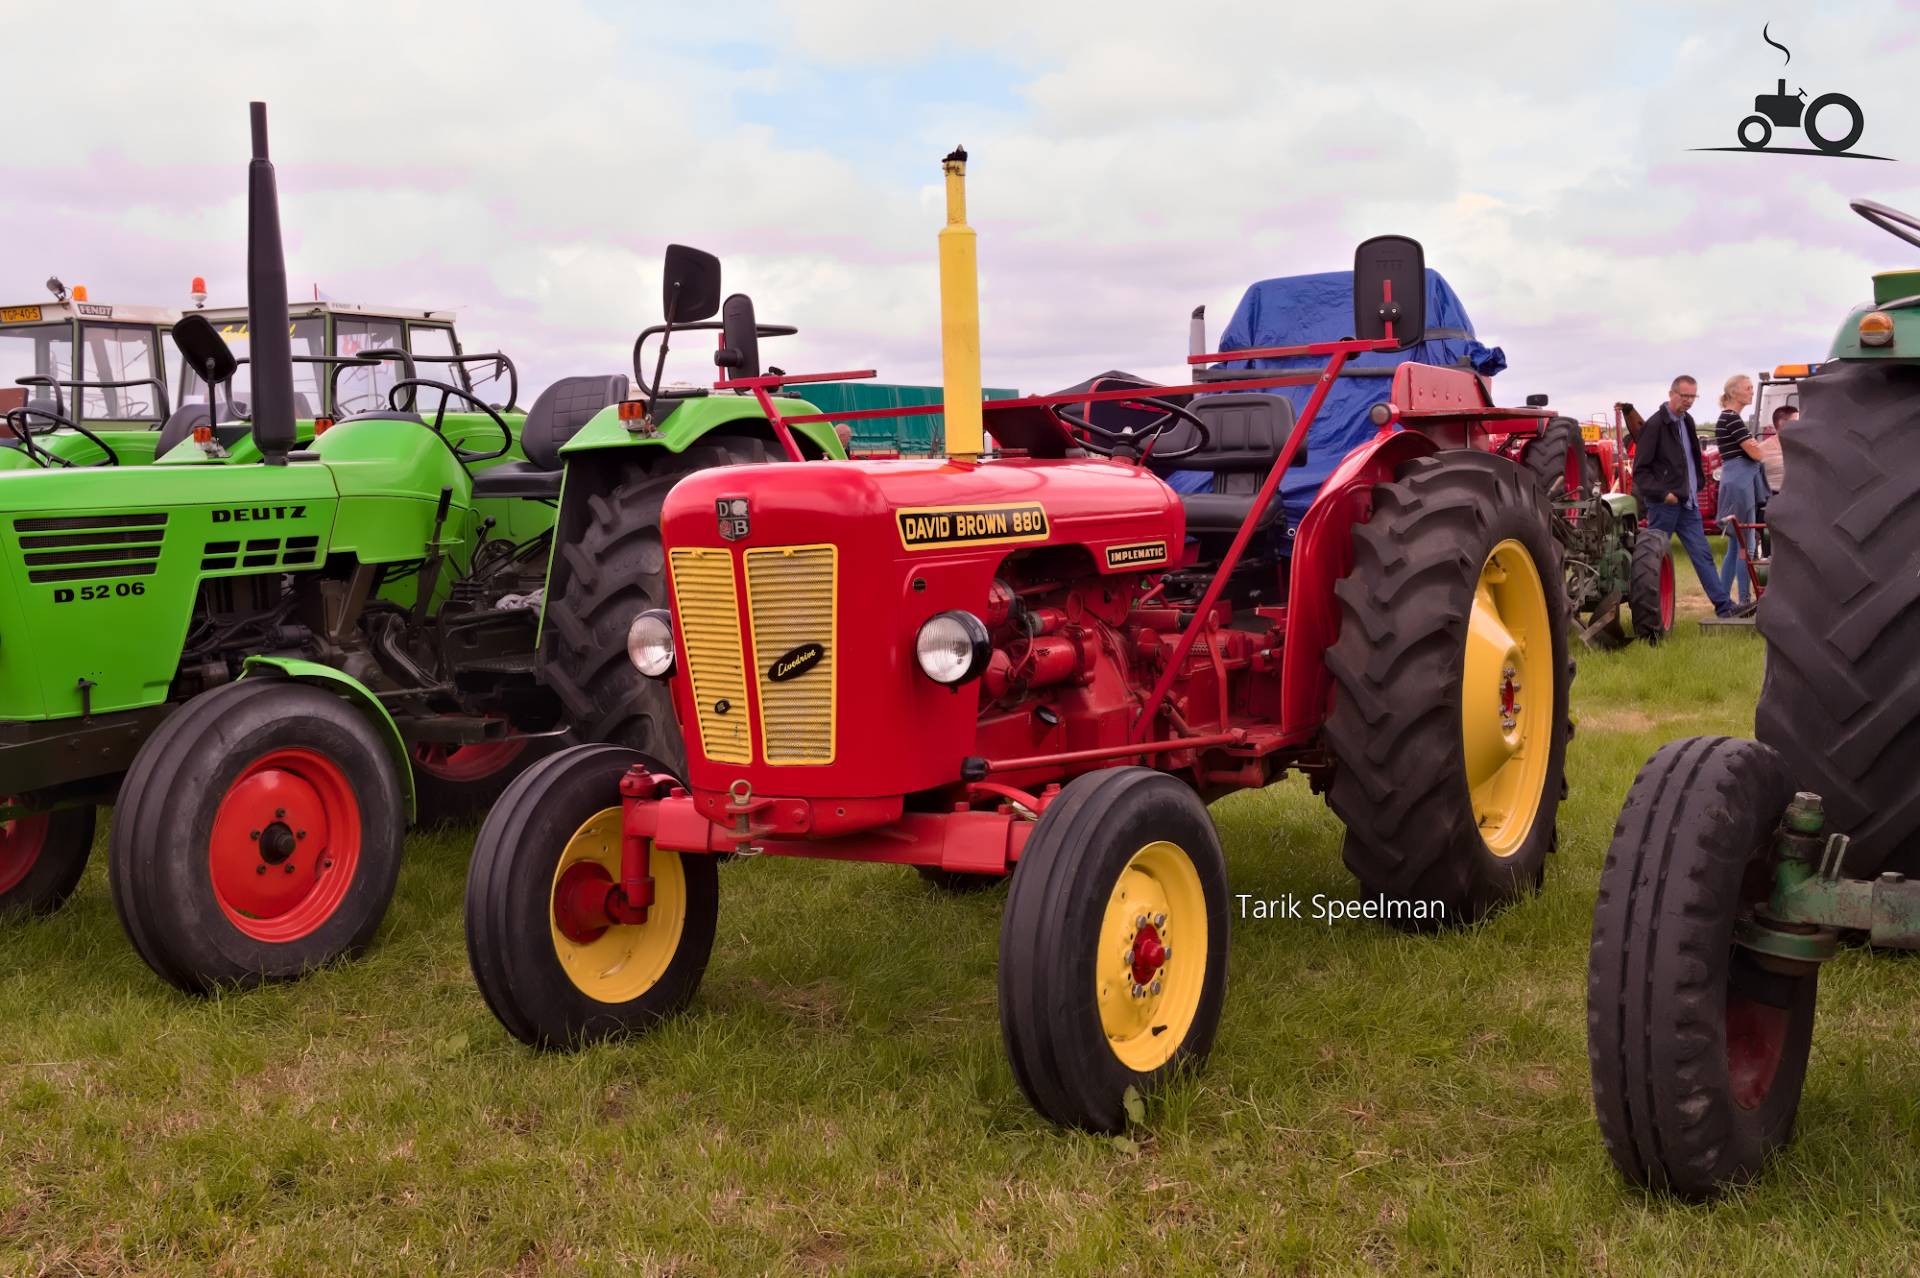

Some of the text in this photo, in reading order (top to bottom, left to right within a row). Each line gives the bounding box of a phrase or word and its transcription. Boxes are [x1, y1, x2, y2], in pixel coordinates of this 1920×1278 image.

[80, 305, 112, 316] FENDT
[212, 506, 307, 523] DEUTZ
[905, 511, 1042, 541] DAVID BROWN 880
[1110, 546, 1164, 562] IMPLEMATIC
[777, 649, 817, 677] Livedrive
